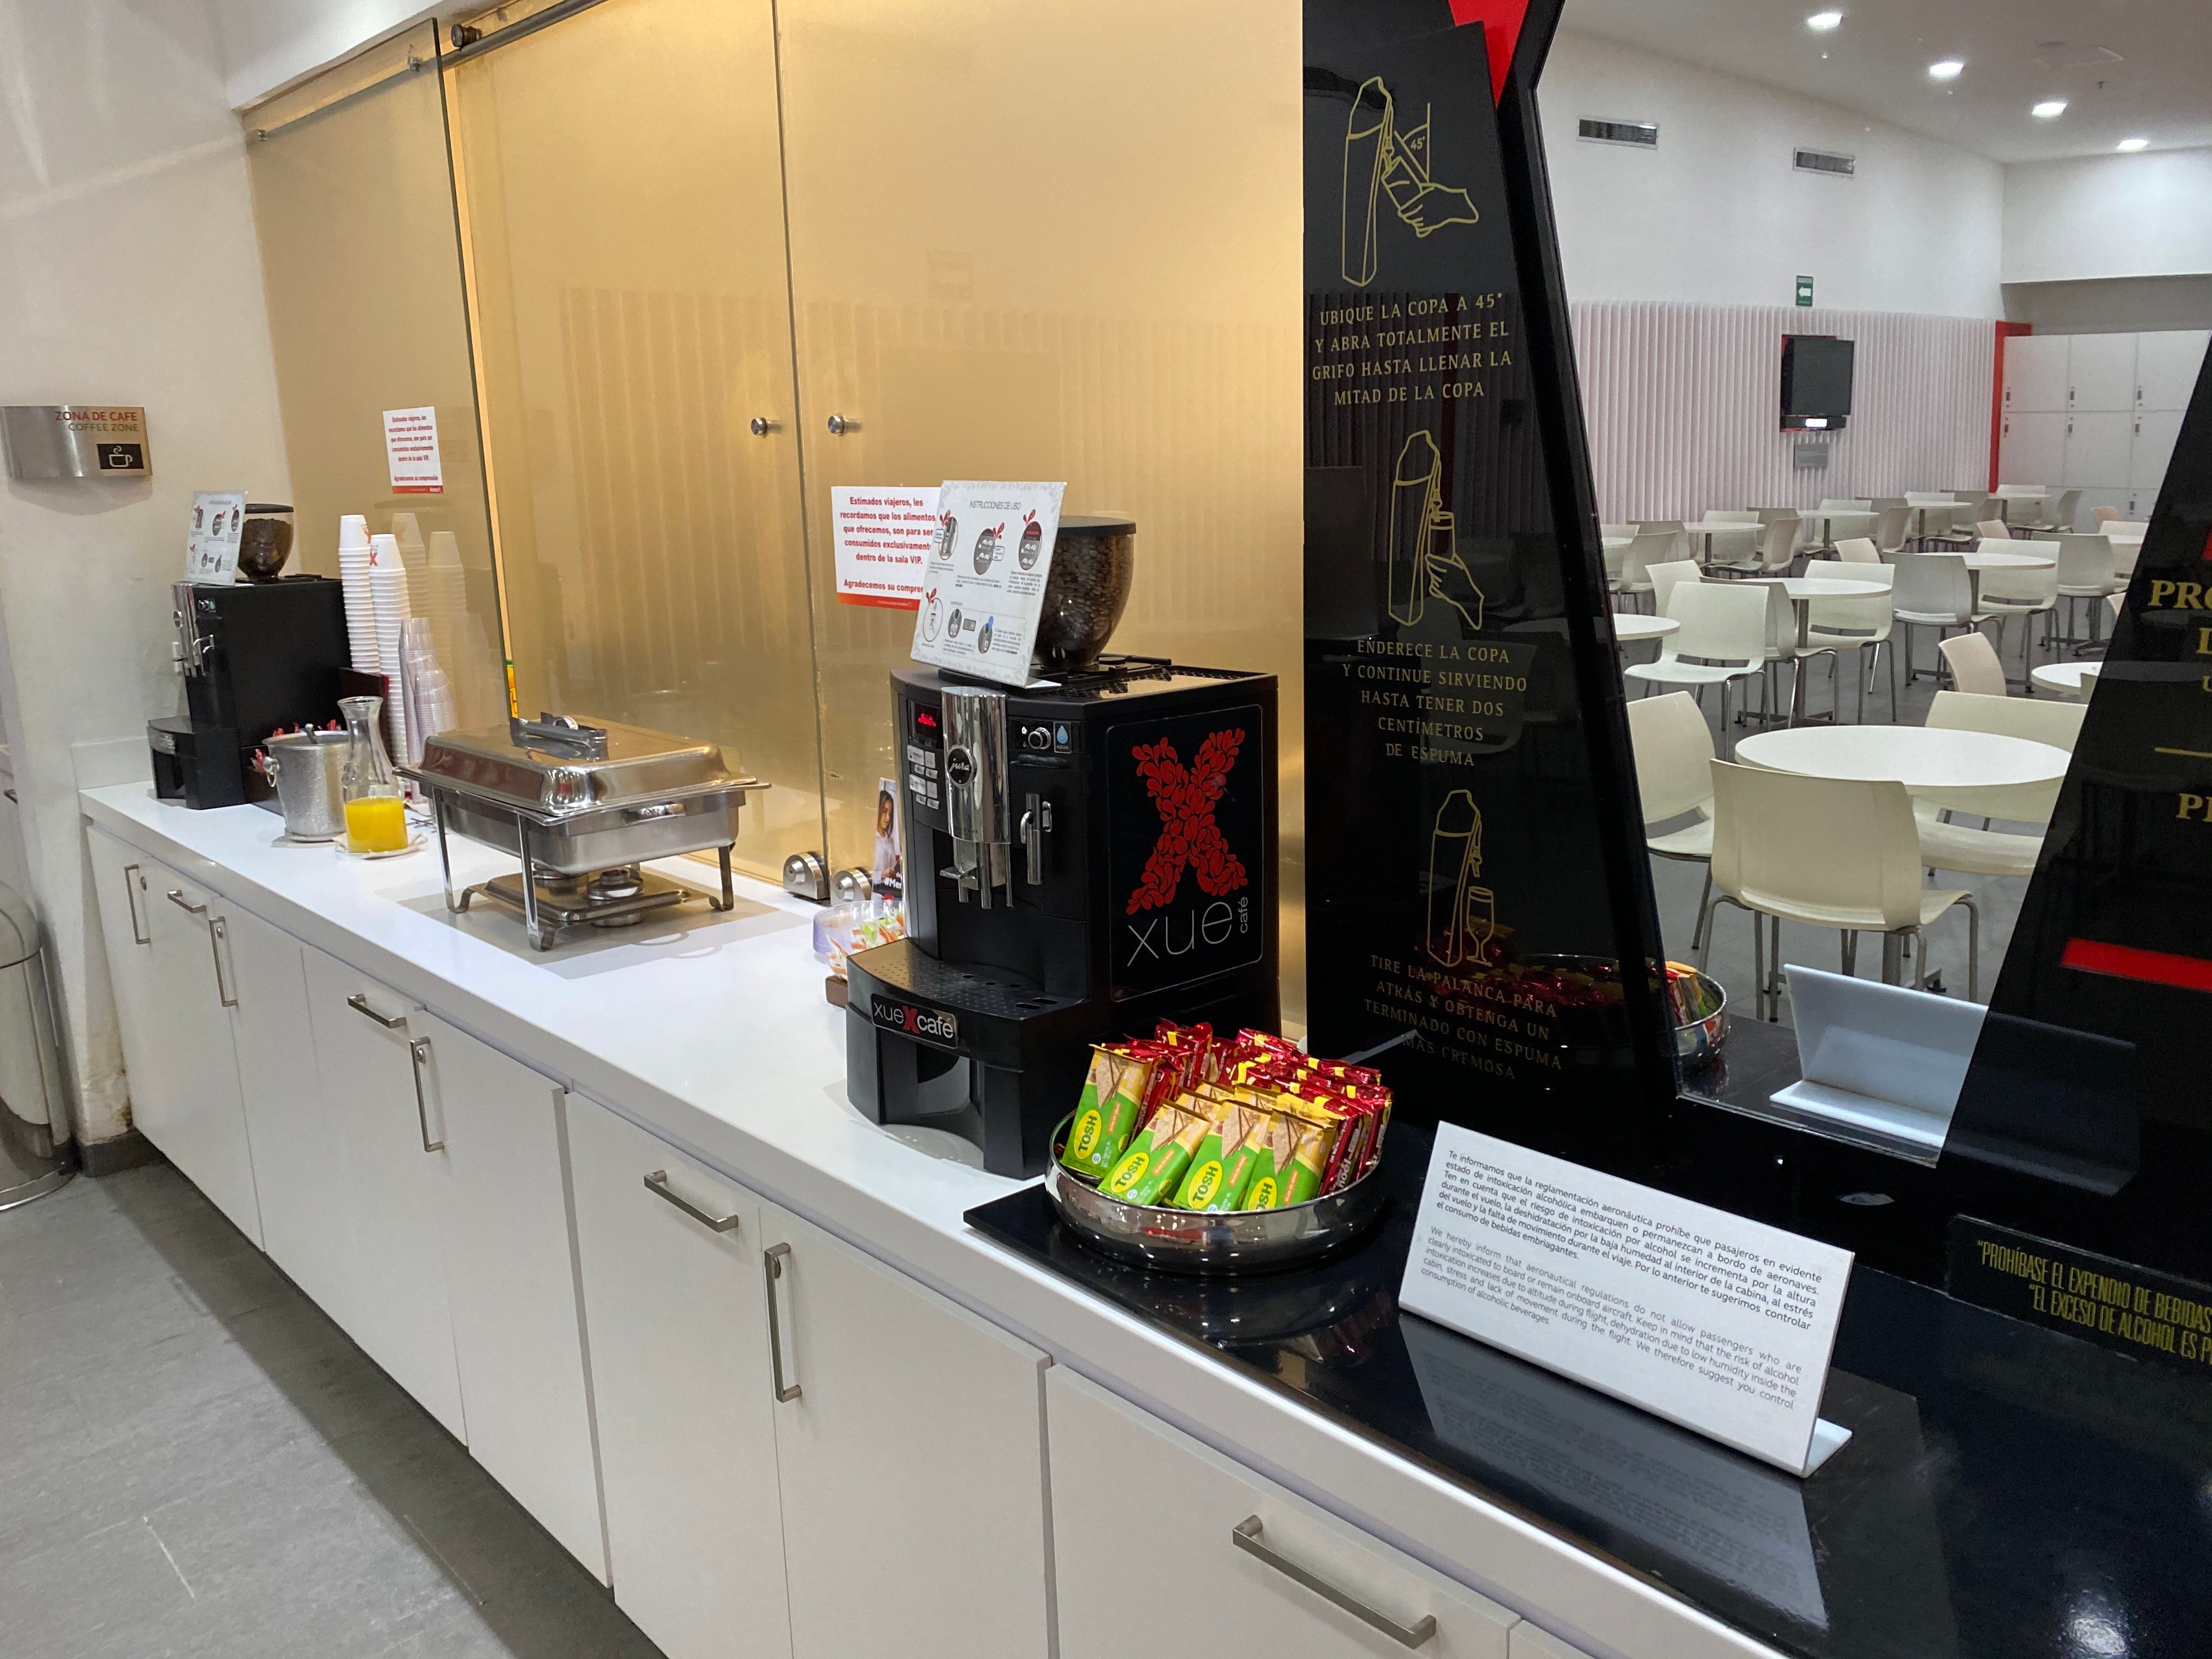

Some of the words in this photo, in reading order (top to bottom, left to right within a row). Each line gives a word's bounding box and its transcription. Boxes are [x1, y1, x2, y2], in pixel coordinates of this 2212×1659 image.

[1320, 306, 1373, 327] UBIQUE
[1381, 303, 1401, 319] LA
[1408, 297, 1448, 316] COPA
[1457, 296, 1467, 311] A
[1315, 338, 1324, 353] Y
[1330, 334, 1370, 351] ABRA
[1376, 323, 1481, 347] TOTALMENTE
[1489, 321, 1509, 337] EL
[1312, 363, 1354, 380] GRIFO
[1362, 358, 1411, 376] HASTA
[1419, 352, 1481, 372] LLENAR
[1490, 350, 1511, 366] LA
[1334, 388, 1381, 406] MITAD
[1389, 387, 1407, 402] DE
[1414, 385, 1434, 400] LA
[1442, 381, 1483, 398] COPA
[55, 411, 89, 421] ZONA
[92, 412, 107, 420] DE
[110, 412, 137, 421] CAFE
[840, 511, 876, 519] recordamos
[903, 512, 935, 521] alimentos
[850, 496, 882, 505] Estimados
[884, 498, 911, 508] viajeros,
[913, 498, 923, 506] les
[843, 526, 854, 534] que
[856, 524, 891, 535] ofrecemos,
[906, 528, 921, 537] para
[844, 538, 881, 548] consumidos
[883, 540, 930, 551] exclusivament
[856, 552, 876, 561] dentro
[895, 555, 908, 563] sala
[910, 555, 922, 564] VIP.
[844, 579, 885, 592] Agradecemos
[2147, 579, 2212, 609] PR
[1357, 639, 1432, 657] ENDERECE
[1440, 645, 1459, 659] LA
[1468, 647, 1509, 663] COPA
[1342, 663, 1351, 676] Y
[1358, 665, 1431, 684] CONTINUE
[1439, 671, 1526, 692] SIRVIENDO
[1361, 690, 1409, 707] HASTA
[1416, 695, 1464, 713] TENER
[1472, 700, 1503, 716] DOS
[1378, 716, 1483, 741] CENTÍMETROS
[949, 758, 970, 773] jura
[1386, 742, 1402, 757] DE
[1412, 746, 1474, 766] ESPUMA
[1239, 895, 1249, 934] café
[1127, 901, 1233, 967] xue
[1370, 953, 1400, 974] TIRE
[1408, 964, 1425, 981] LA
[1434, 972, 1504, 1003] PALANCA
[1514, 994, 1556, 1018] PARA
[1430, 995, 1438, 1009] Y
[1445, 998, 1519, 1032] OBTENGA
[1527, 1022, 1548, 1040] UN
[1364, 998, 1448, 1035] TERMINADO
[1457, 1026, 1486, 1047] CON
[1496, 1037, 1561, 1069] ESPUMA
[1078, 1115, 1098, 1152] TOSH
[1115, 1156, 1146, 1190] TOSH
[1192, 1165, 1219, 1202] TOSH
[1339, 1159, 1352, 1188] noel
[1256, 1182, 1273, 1210] OSH
[1446, 1162, 1471, 1175] estado
[1474, 1171, 1483, 1180] de
[1487, 1174, 1532, 1197] intoxicación
[1536, 1192, 1577, 1212] alcohólica
[1580, 1208, 1629, 1230] embarquen
[1642, 1229, 1703, 1255] permanezcan
[1707, 1251, 1713, 1260] a
[1717, 1252, 1746, 1269] bordo
[1750, 1265, 1763, 1276] de
[1767, 1272, 1819, 1295] aeronaves.
[1447, 1149, 1458, 1160] Te
[1459, 1154, 1505, 1176] informamos
[1507, 1172, 1522, 1182] que
[1525, 1176, 1532, 1186] la
[1535, 1182, 1599, 1208] reglamentación
[1601, 1204, 1652, 1227] aeronáutica
[1655, 1222, 1691, 1239] prohíbe
[1694, 1235, 1712, 1246] que
[1714, 1242, 1759, 1262] pasajeros
[1763, 1259, 1775, 1268] en
[1779, 1263, 1822, 1283] evidente
[1441, 1181, 1470, 1197] durante
[1471, 1192, 1479, 1201] el
[1480, 1195, 1503, 1210] vuelo,
[1504, 1203, 1512, 1212] la
[1514, 1206, 1572, 1234] deshidratación
[1573, 1229, 1589, 1239] por
[1590, 1233, 1598, 1243] la
[1600, 1236, 1618, 1250] baja
[1620, 1243, 1662, 1265] humedad
[1663, 1261, 1673, 1269] al
[1674, 1262, 1708, 1281] interior
[1709, 1276, 1722, 1286] de
[1724, 1279, 1733, 1290] la
[1735, 1286, 1769, 1305] cabina,
[1771, 1298, 1781, 1307] al
[1784, 1303, 1814, 1318] estrés
[1442, 1169, 1457, 1181] Ten
[1460, 1177, 1469, 1186] en
[1472, 1182, 1498, 1196] cuenta
[1502, 1192, 1517, 1203] que
[1520, 1198, 1528, 1207] el
[1530, 1201, 1555, 1216] riesgo
[1558, 1211, 1569, 1221] de
[1572, 1215, 1622, 1239] intoxicación
[1625, 1235, 1641, 1245] por
[1644, 1242, 1677, 1259] alcohol
[1680, 1255, 1691, 1263] se
[1695, 1257, 1748, 1284] incrementa
[1752, 1279, 1770, 1290] por
[1773, 1284, 1782, 1295] la
[1786, 1290, 1816, 1307] altura
[2052, 1261, 2063, 1289] EL
[2069, 1266, 2131, 1310] EXPENDIO
[2134, 1285, 2150, 1316] DE
[2051, 1289, 2096, 1328] EXCESO
[2099, 1304, 2115, 1335] DE
[2118, 1310, 2175, 1353] ALCOHOL
[2181, 1330, 2197, 1361] ES
